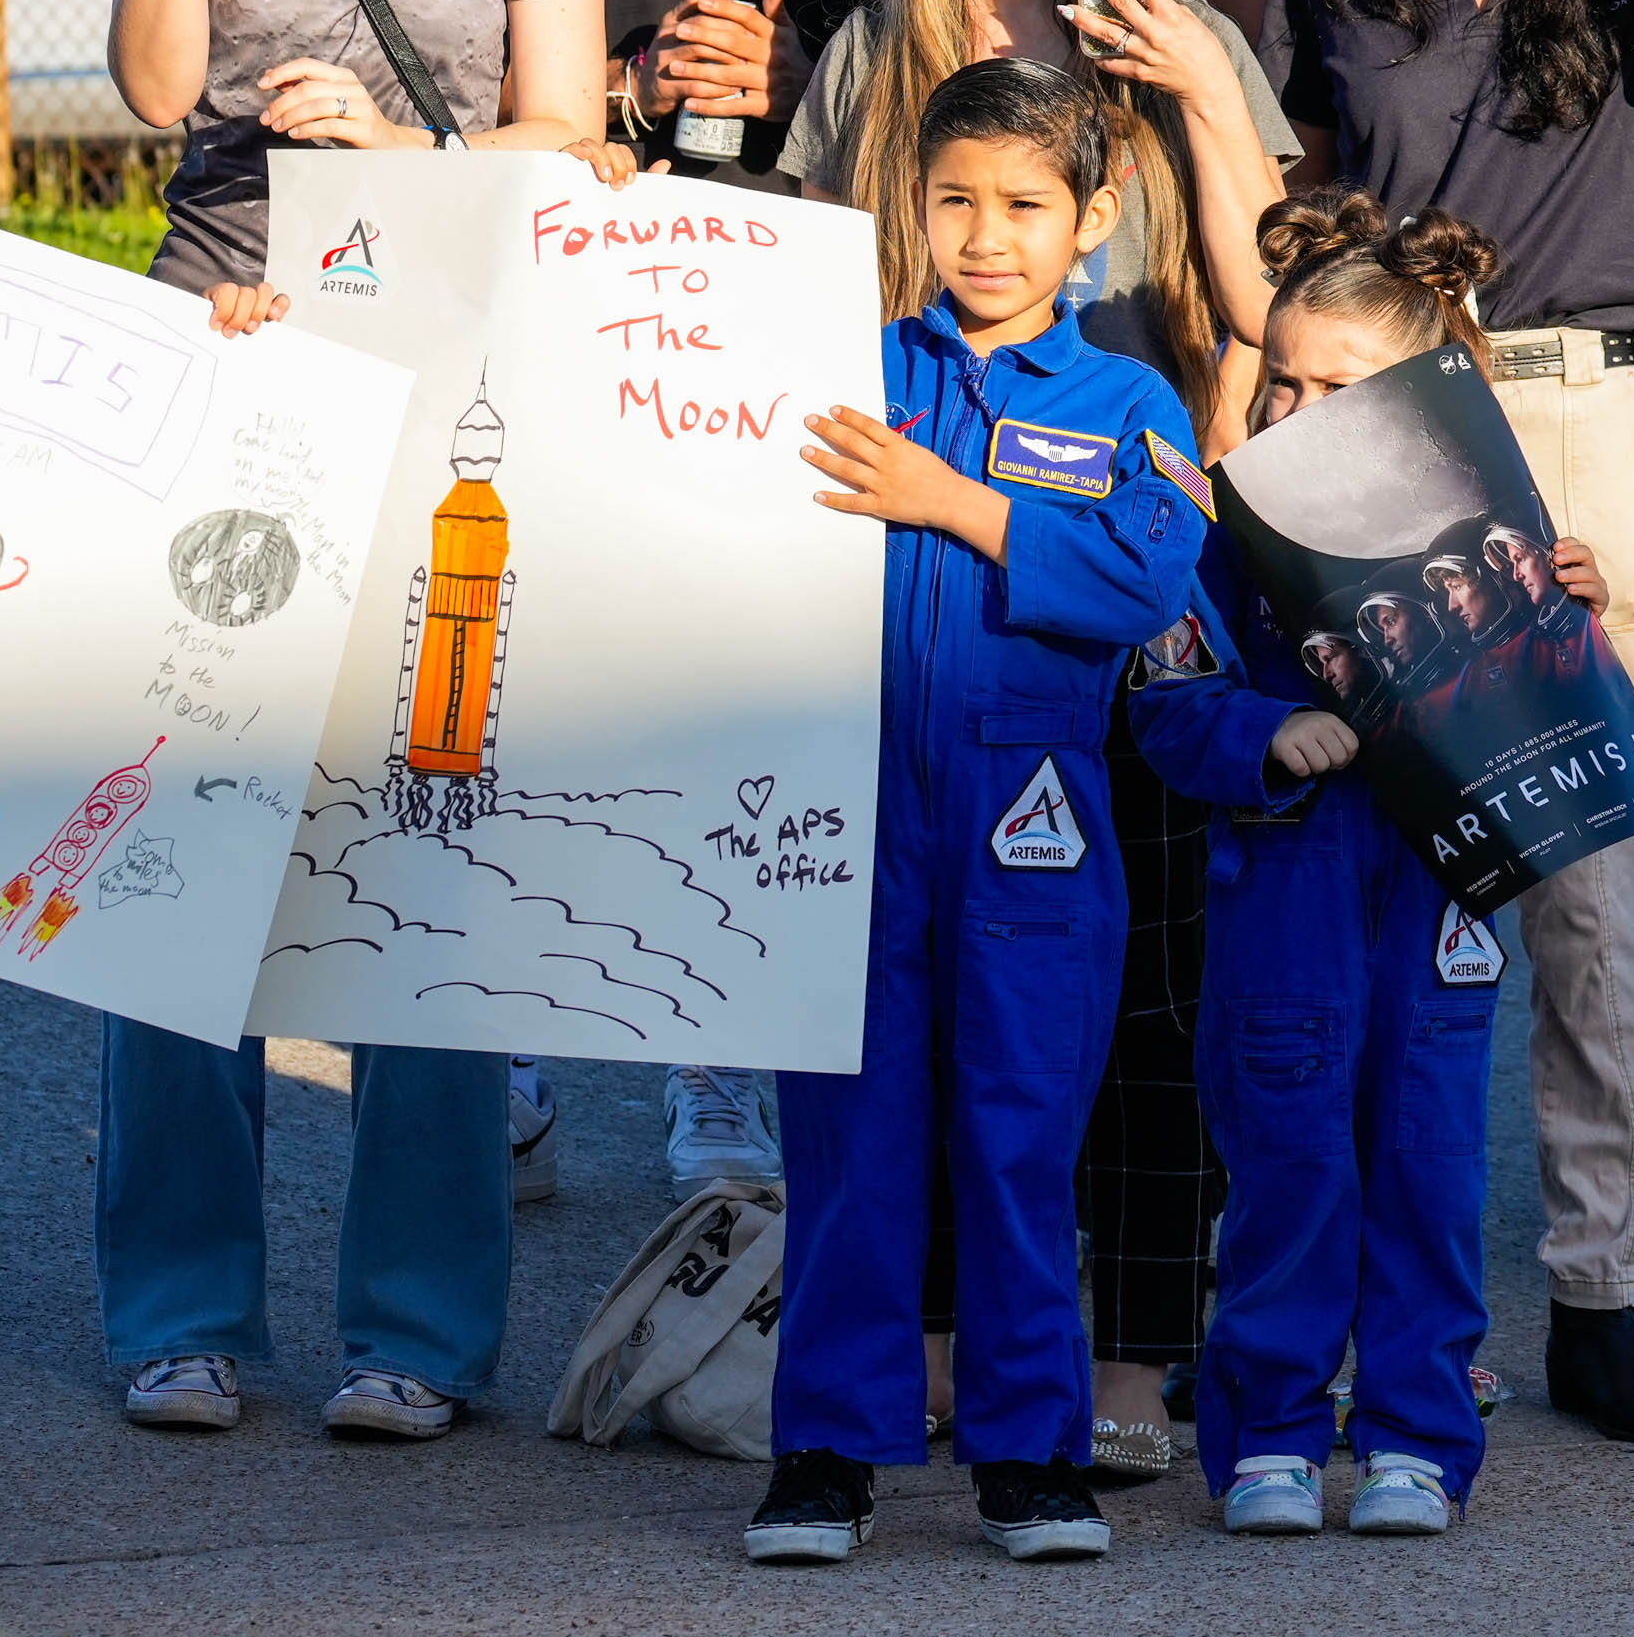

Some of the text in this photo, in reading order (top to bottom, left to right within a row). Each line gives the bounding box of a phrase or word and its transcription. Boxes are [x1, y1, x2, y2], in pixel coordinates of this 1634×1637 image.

[319, 280, 379, 299] ARTEMIS
[627, 265, 709, 295] TO
[597, 314, 723, 352] The
[997, 460, 1104, 491] GIOVANNI RAMIREZ-TAPIA
[165, 619, 236, 660] Mission
[189, 667, 216, 688] the
[1460, 720, 1606, 796] AROUND THE MOON FOR ALL HUMANITY
[1485, 759, 1494, 769] 10
[1495, 747, 1517, 763] DAYS
[1555, 719, 1578, 733] MILES
[1432, 742, 1627, 864] ARTEMIS
[1586, 804, 1627, 824] CHRISTINA KOCH
[705, 807, 846, 862] The APS
[1519, 831, 1565, 859] VICTOR GLOVER
[1009, 846, 1066, 860] ARTEMIS
[755, 857, 855, 892] office
[1449, 963, 1490, 977] ARTEMIS
